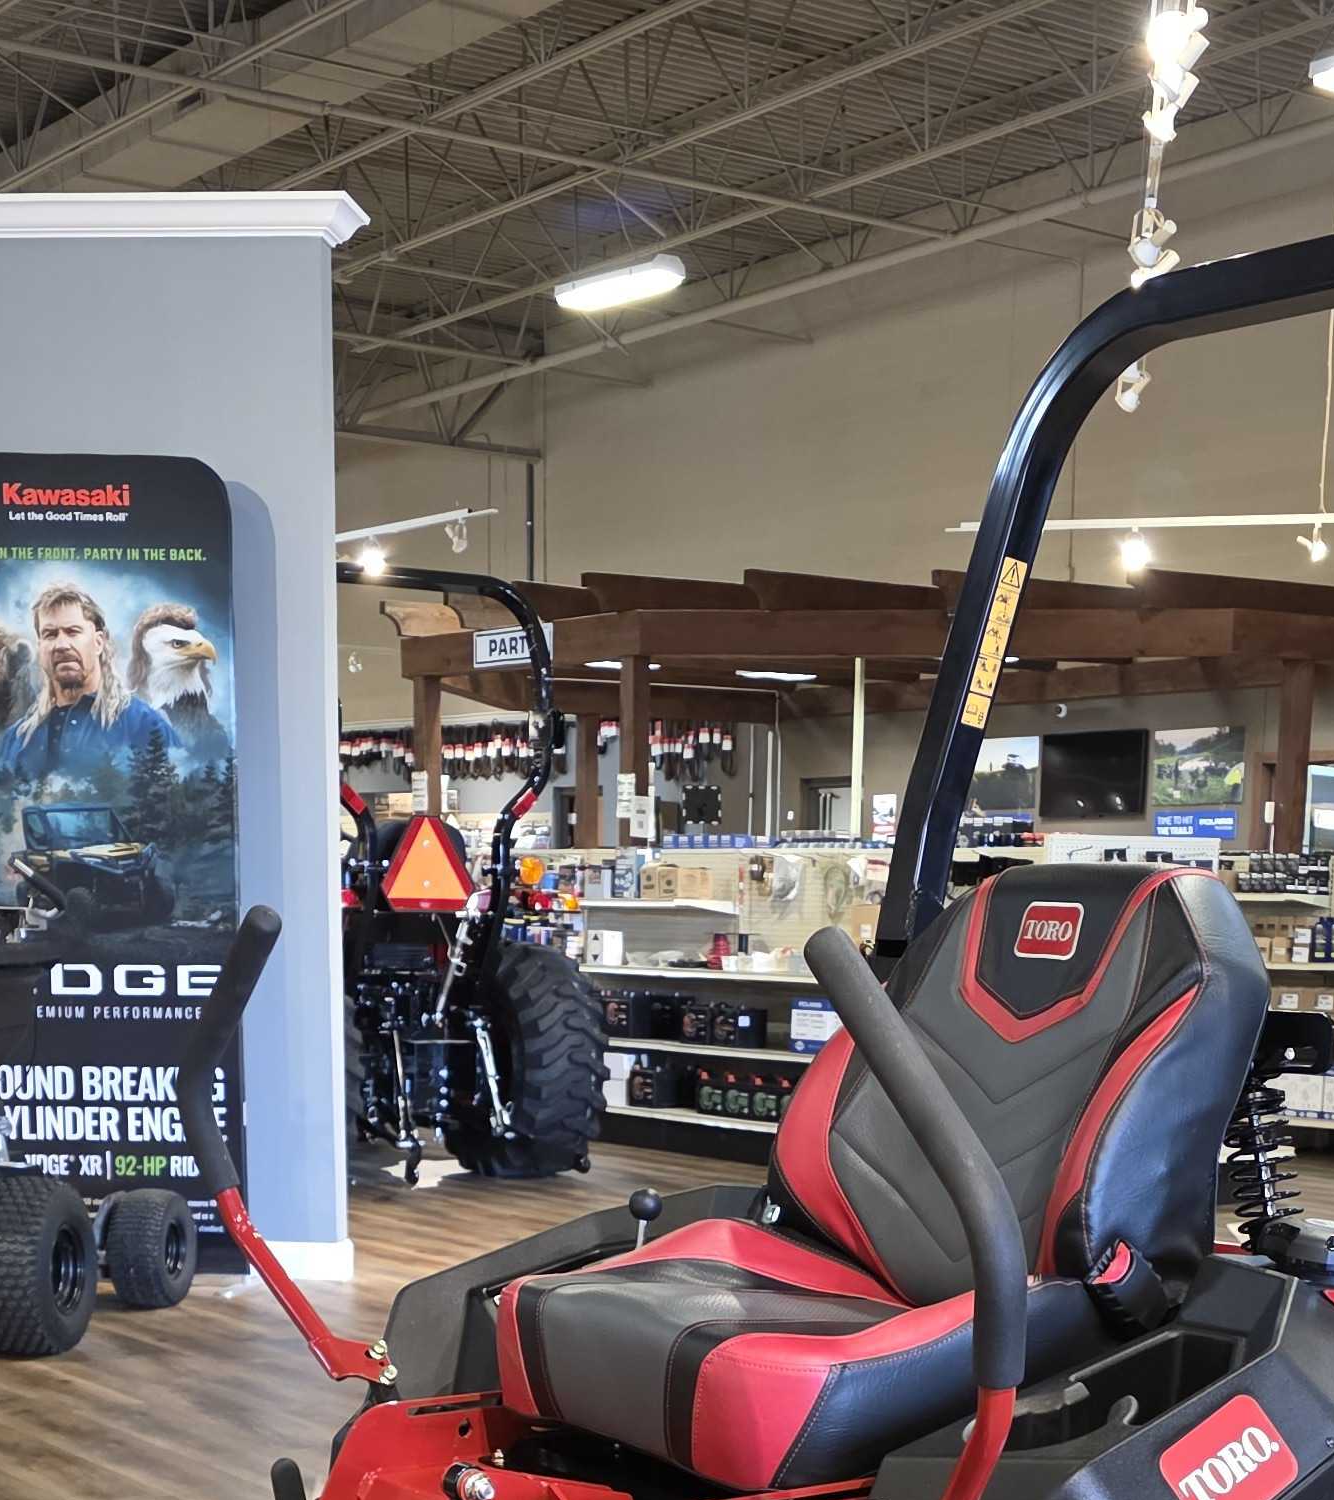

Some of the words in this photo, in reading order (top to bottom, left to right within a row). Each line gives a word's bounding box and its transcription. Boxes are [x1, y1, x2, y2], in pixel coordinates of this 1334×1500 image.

[2, 482, 130, 506] Kawasaki
[8, 511, 25, 521] Let
[27, 511, 44, 521] the
[45, 511, 73, 521] Good
[74, 511, 104, 522] Times
[11, 547, 34, 560] THE
[37, 547, 80, 561] FRONT.
[84, 547, 122, 561] PARTY
[127, 548, 140, 561] IN
[143, 548, 166, 561] THE
[169, 548, 207, 562] BACK.
[489, 634, 529, 657] PART
[1023, 919, 1072, 942] TORO
[50, 963, 223, 997] DGE
[36, 1005, 85, 1019] EMIUM
[93, 1006, 203, 1020] PERFORMANCE
[3, 1105, 121, 1141] YLINDER
[78, 1154, 103, 1176] XR
[114, 1155, 167, 1176] 92-HP
[169, 1155, 201, 1177] RID
